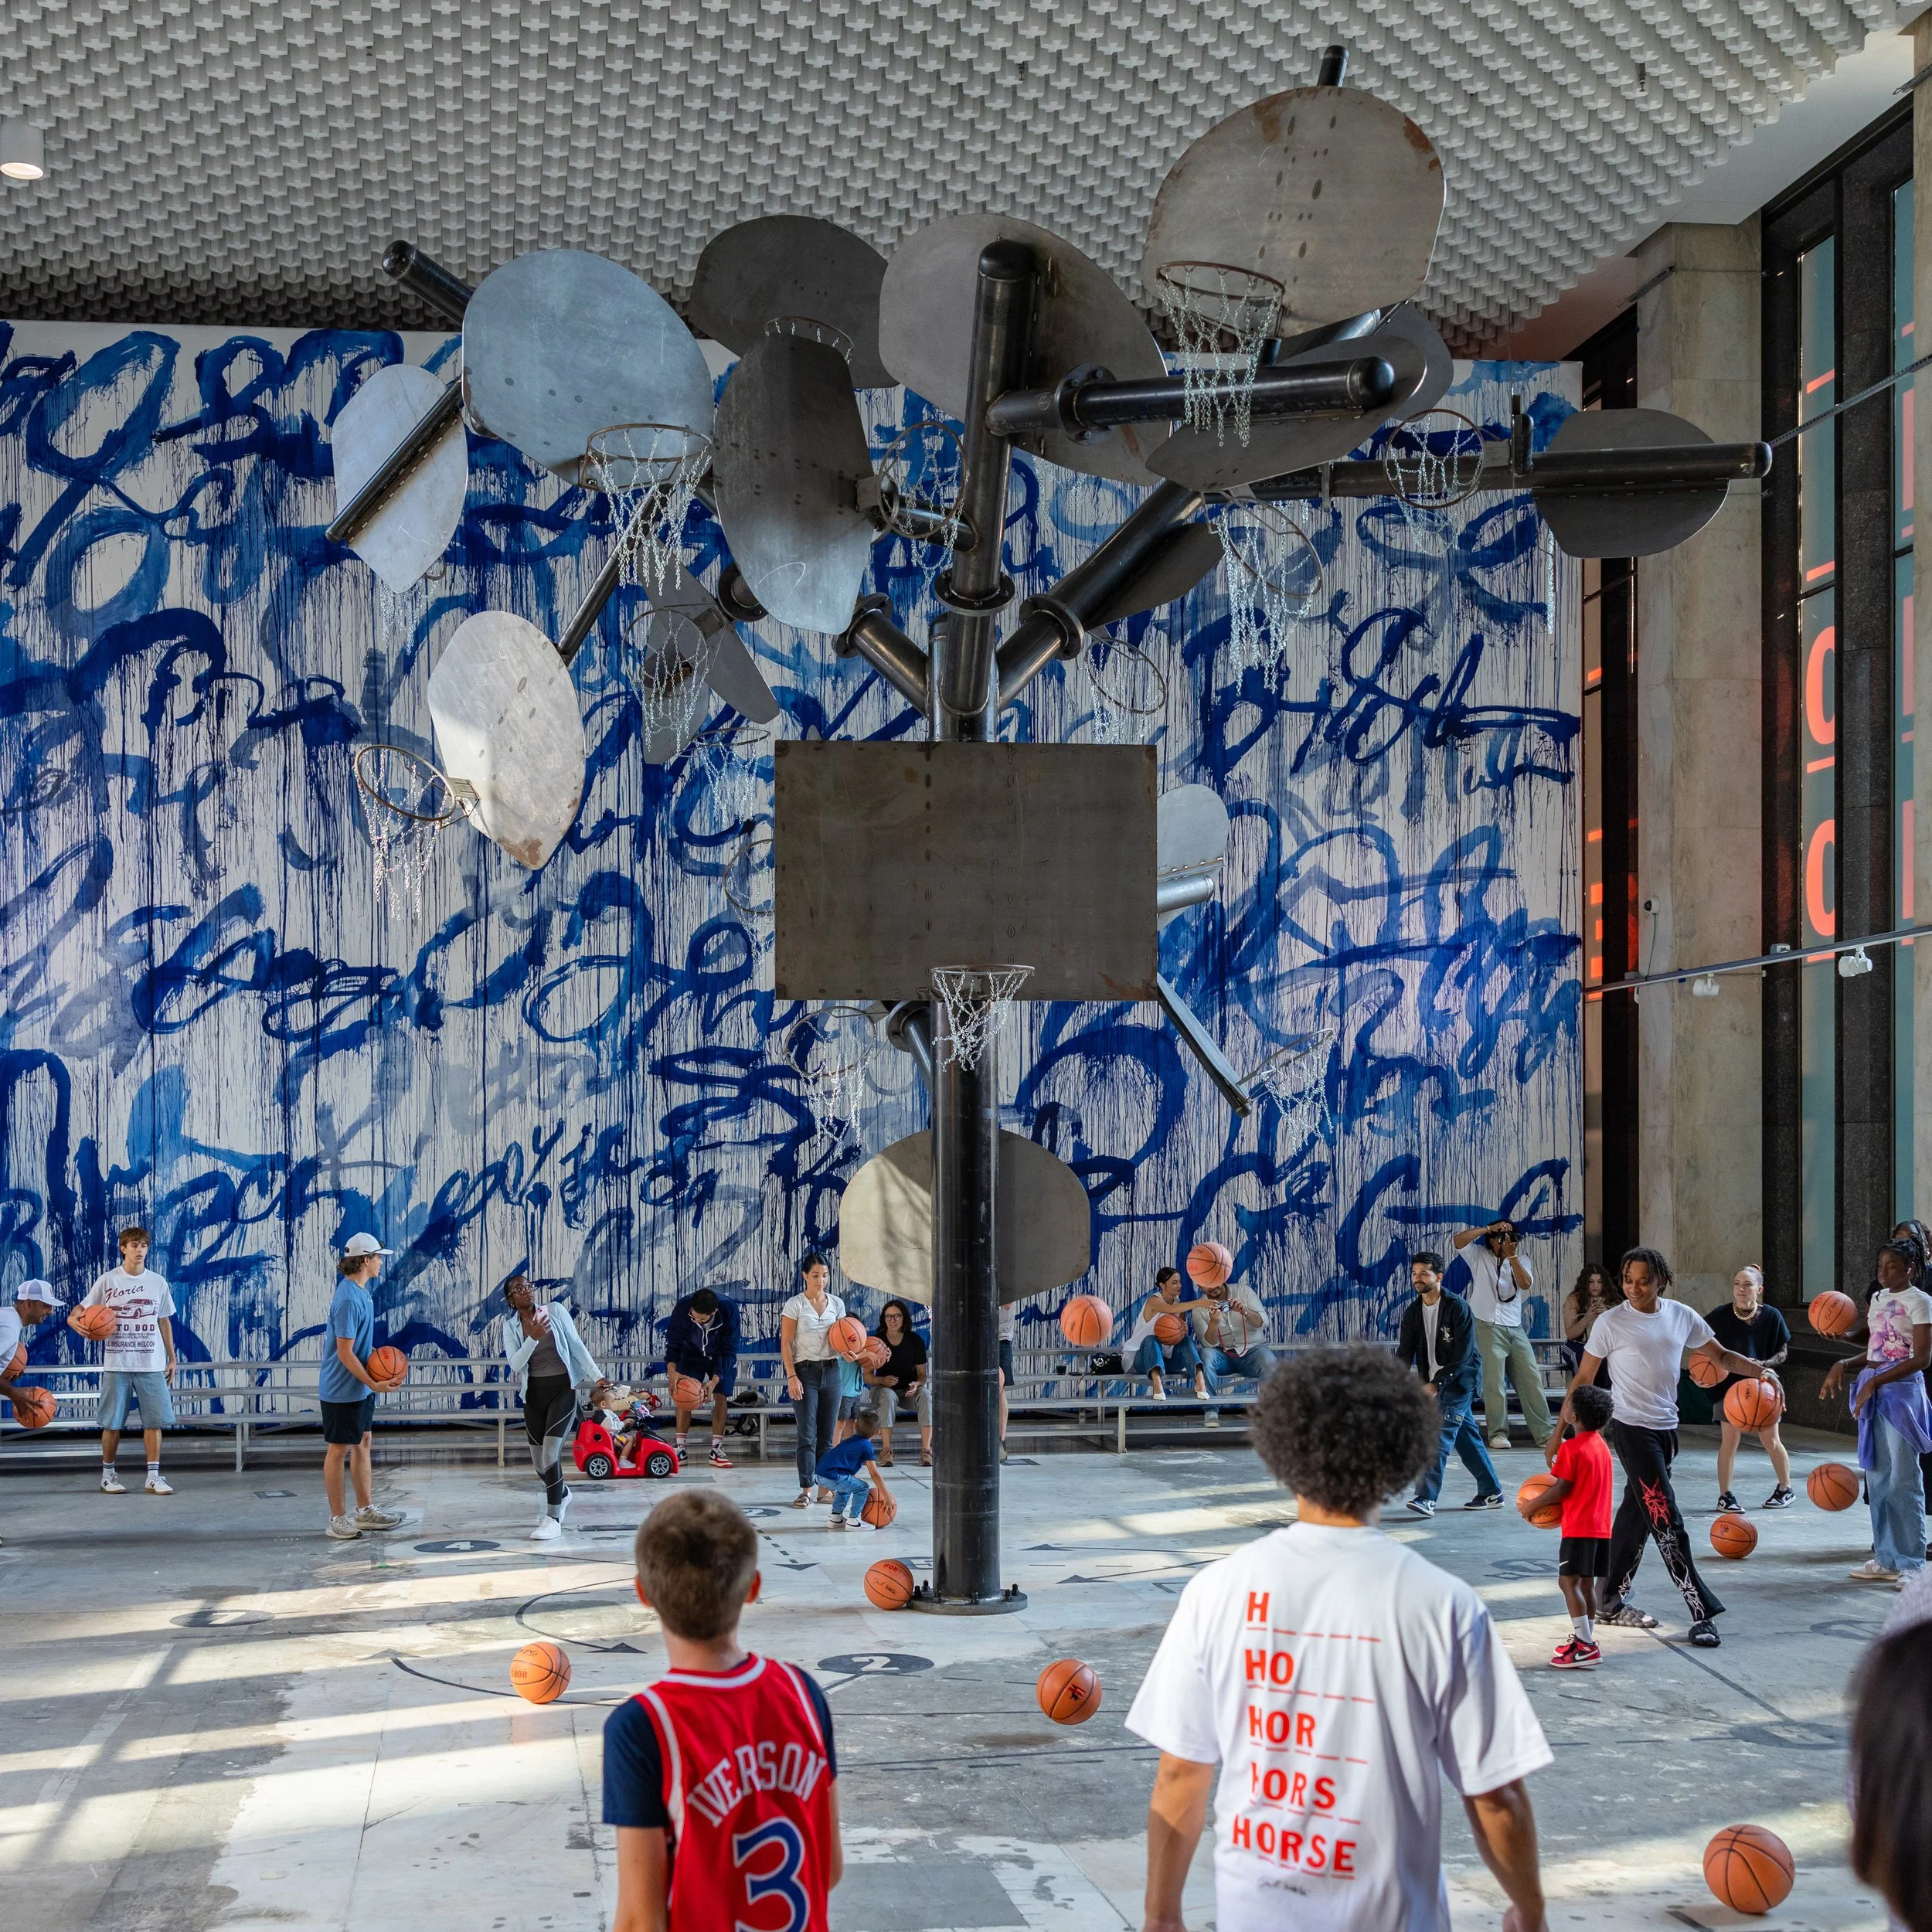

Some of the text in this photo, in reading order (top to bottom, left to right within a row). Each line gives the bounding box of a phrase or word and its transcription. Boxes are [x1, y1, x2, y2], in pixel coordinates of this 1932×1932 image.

[444, 1541, 474, 1550] 4
[208, 1611, 247, 1624] 7
[1247, 1592, 1270, 1623] H
[851, 1655, 900, 1672] 2
[1245, 1649, 1294, 1685] HO
[1249, 1705, 1316, 1749] HOR
[686, 1740, 828, 1828] IVERSON
[1233, 1814, 1358, 1872] HORSE
[733, 1816, 810, 1932] 3
